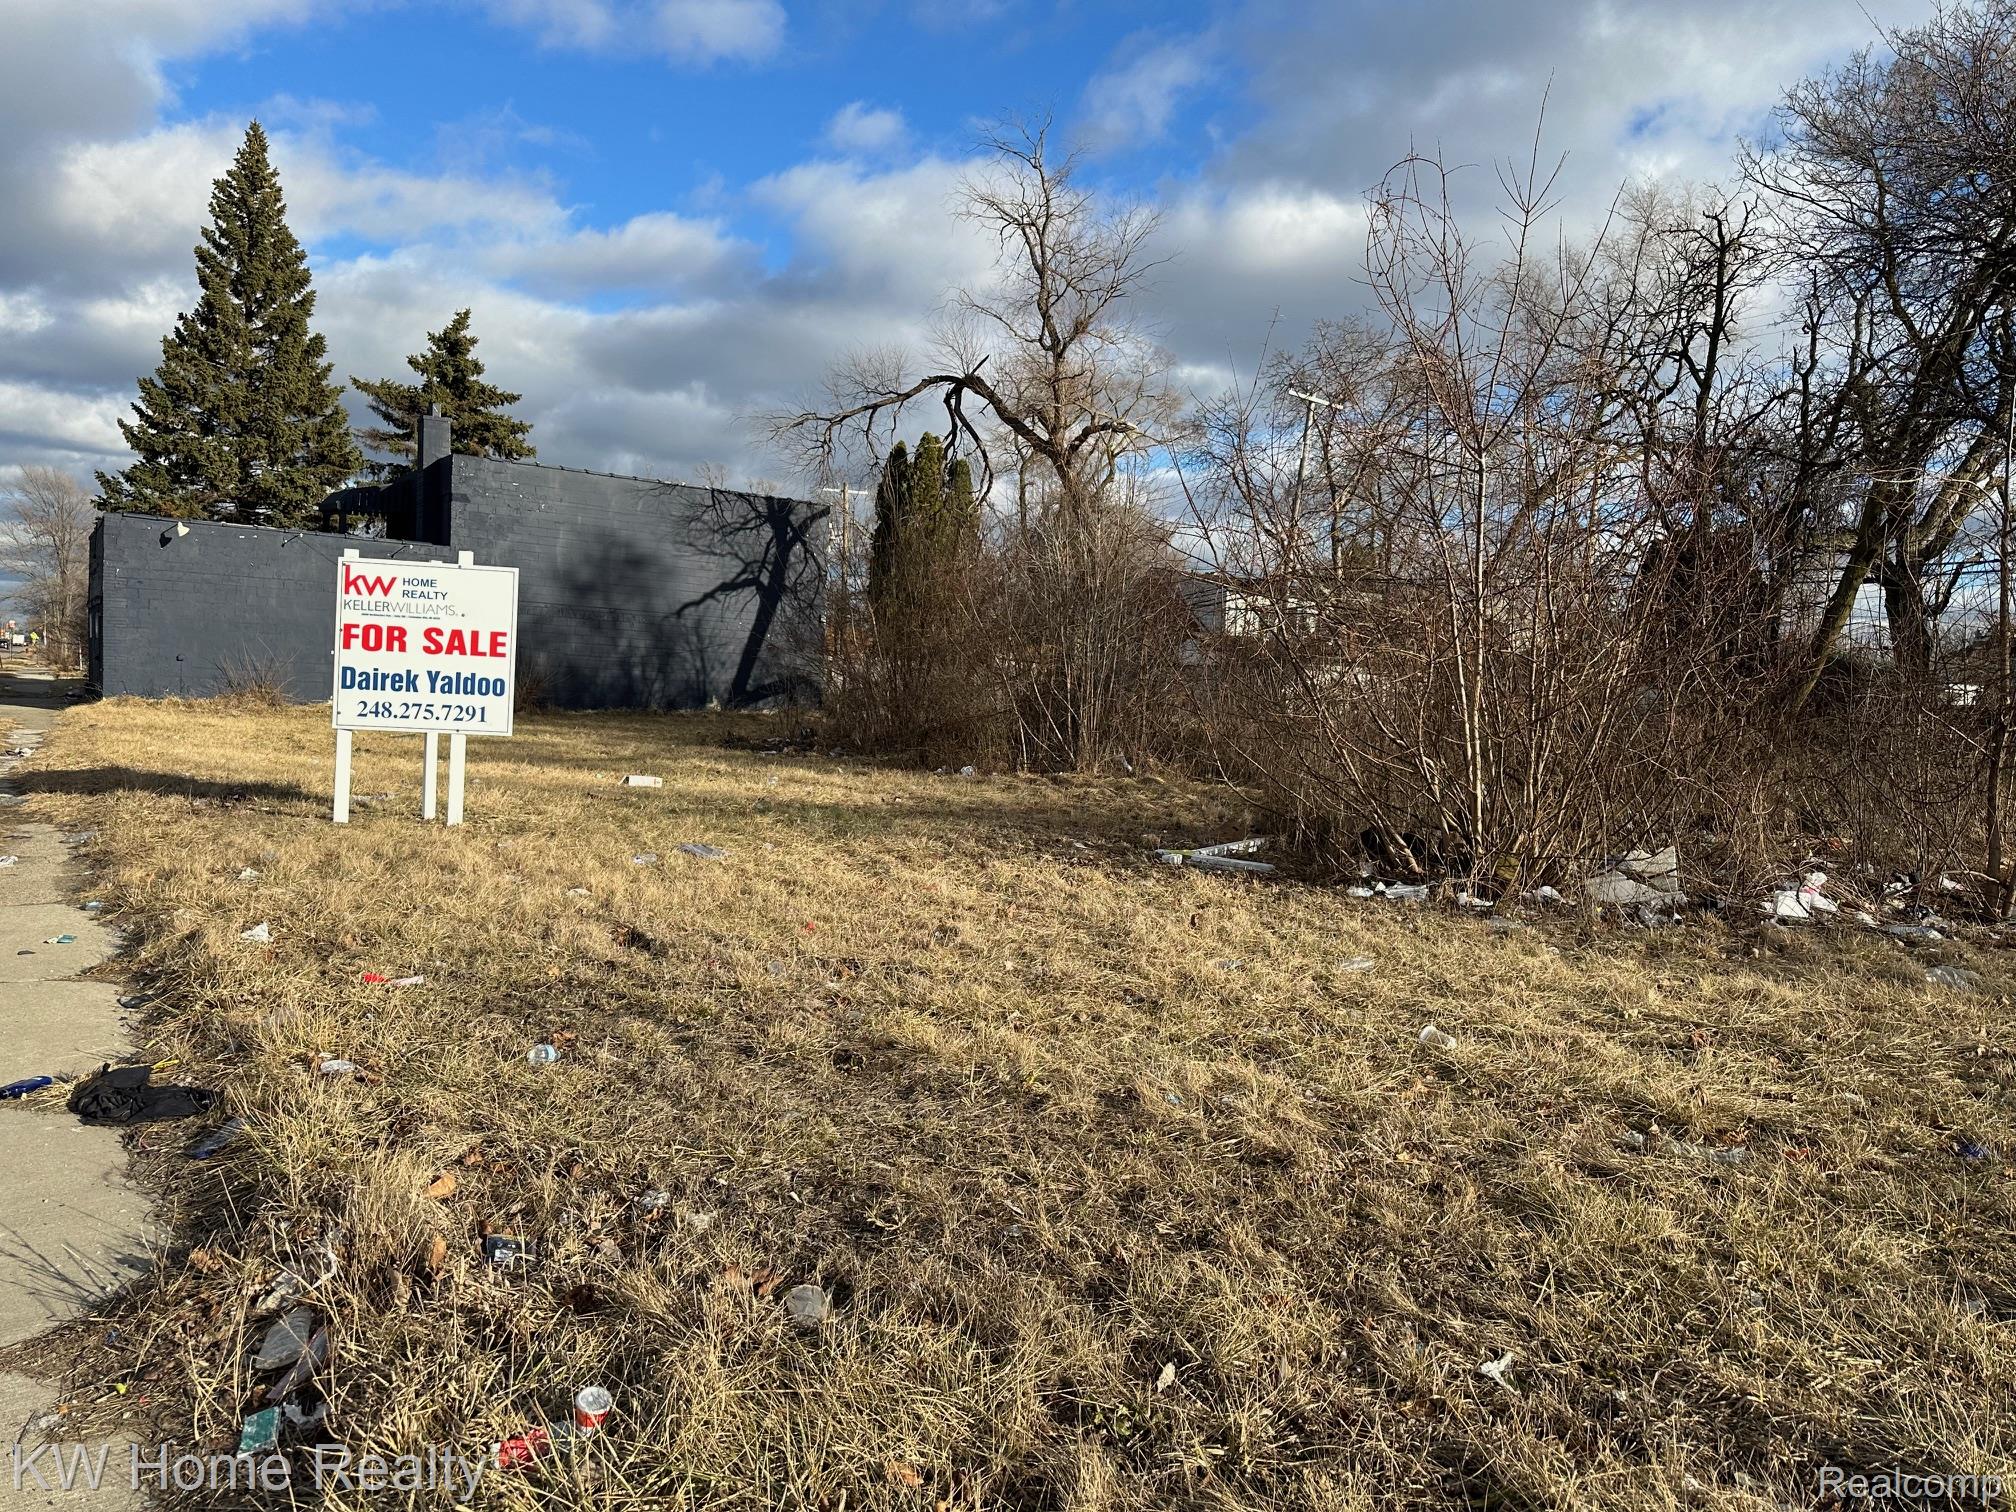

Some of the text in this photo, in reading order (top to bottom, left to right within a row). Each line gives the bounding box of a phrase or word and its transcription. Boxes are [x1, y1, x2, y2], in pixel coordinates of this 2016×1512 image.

[402, 577, 437, 588] HOME
[402, 589, 448, 600] REALTY
[342, 623, 508, 658] FOR SALE
[341, 666, 506, 697] Dairek Yaldoo
[356, 700, 487, 723] 248.275.7291
